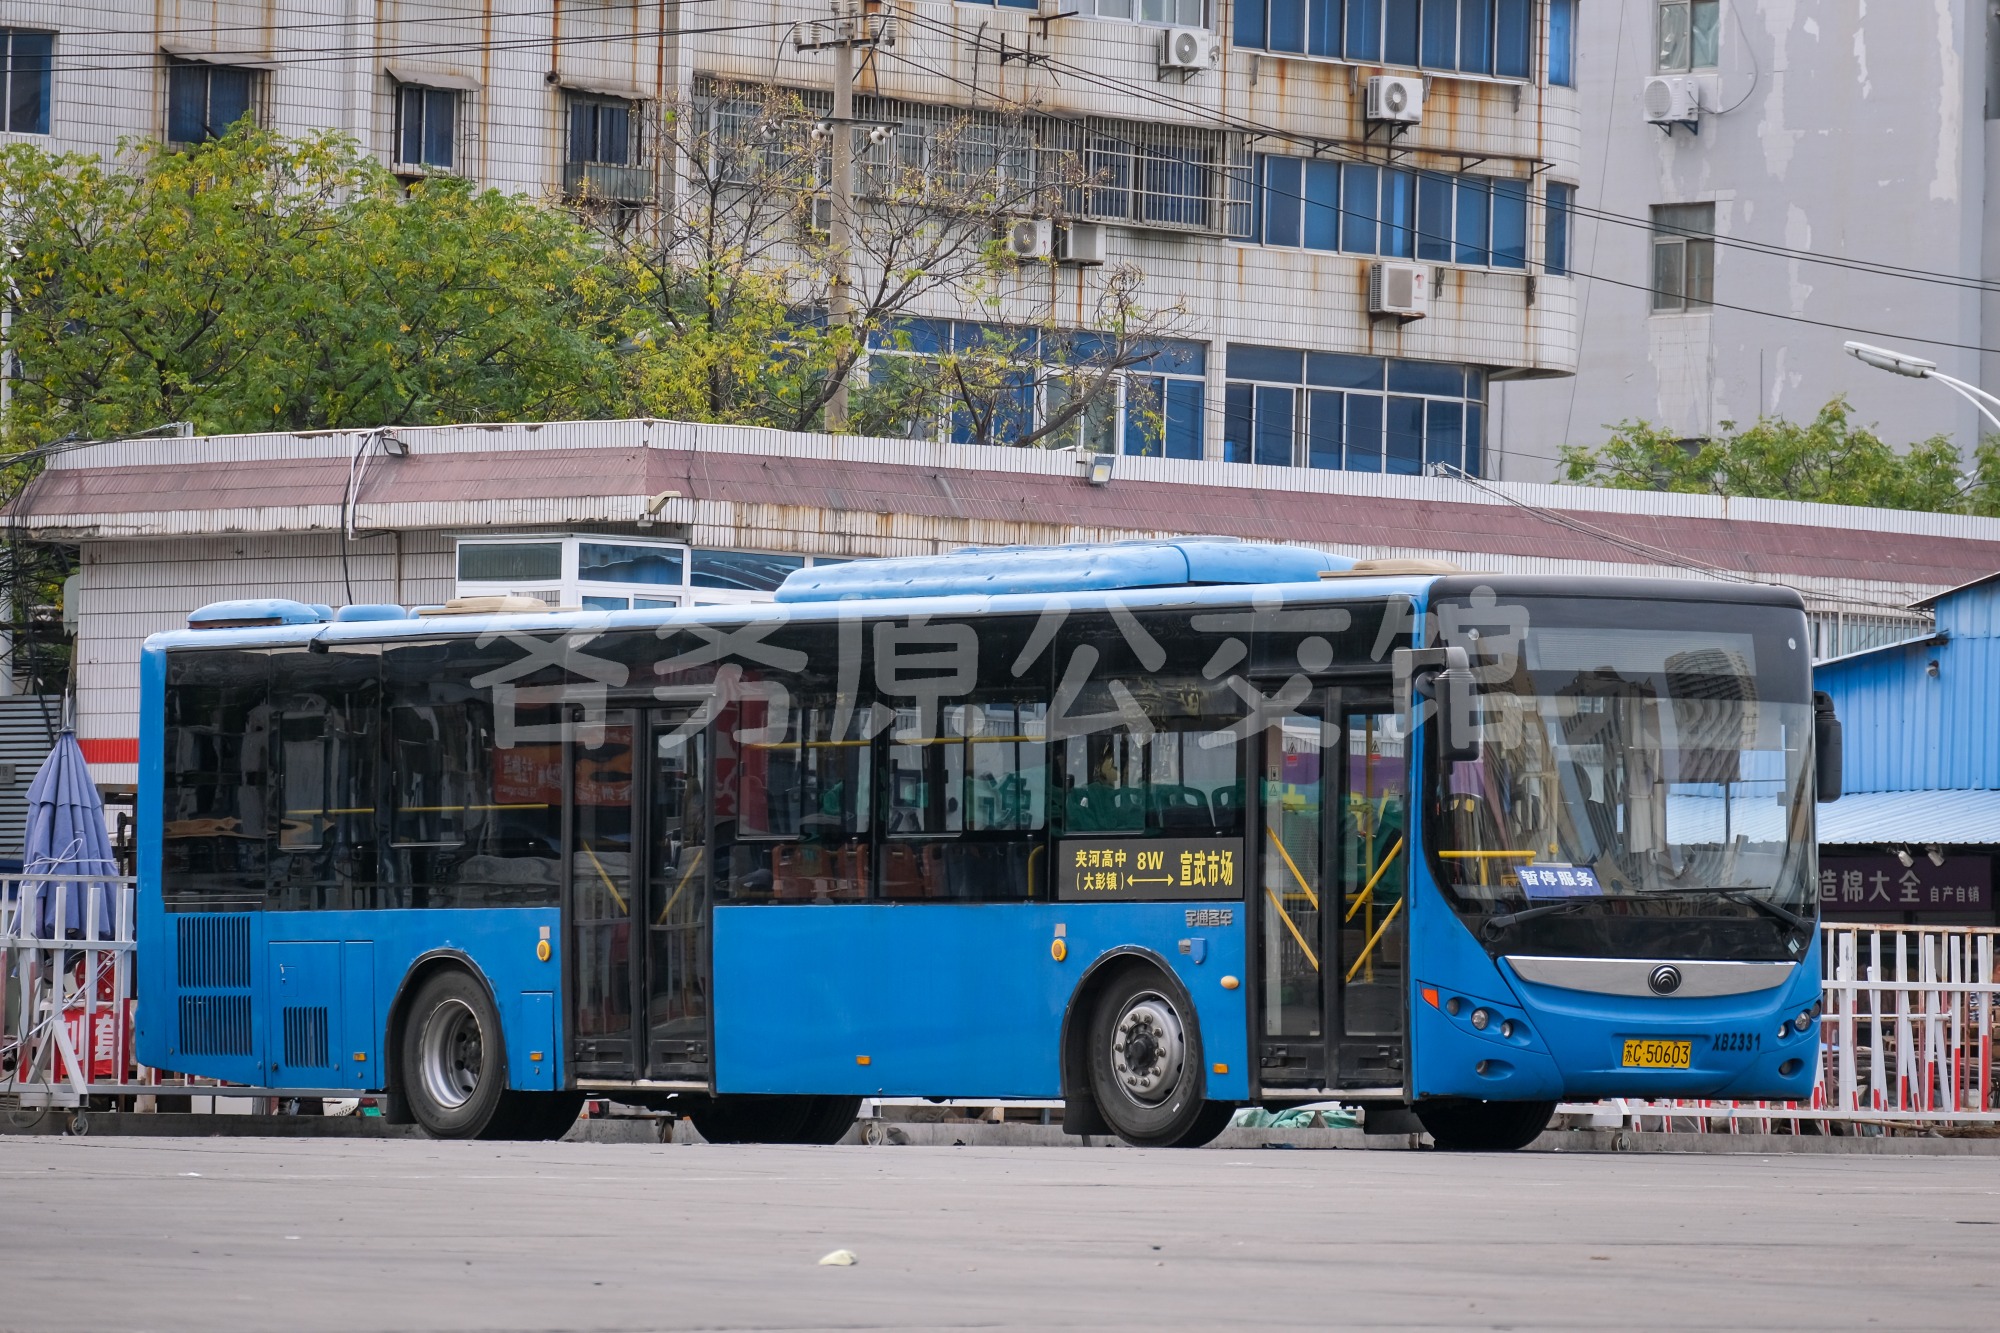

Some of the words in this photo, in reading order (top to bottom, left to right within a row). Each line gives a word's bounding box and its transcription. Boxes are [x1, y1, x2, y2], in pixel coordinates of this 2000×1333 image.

[1075, 849, 1127, 869] 夹河高中
[1137, 851, 1164, 871] 8W
[1179, 850, 1234, 888] 宣武市场
[1519, 869, 1594, 887] 暂停服务
[1818, 868, 1922, 904] 造棉大全
[1929, 885, 1981, 904] 自产自销
[1185, 909, 1234, 928] 宇通客车
[1711, 1032, 1762, 1052] XB2331
